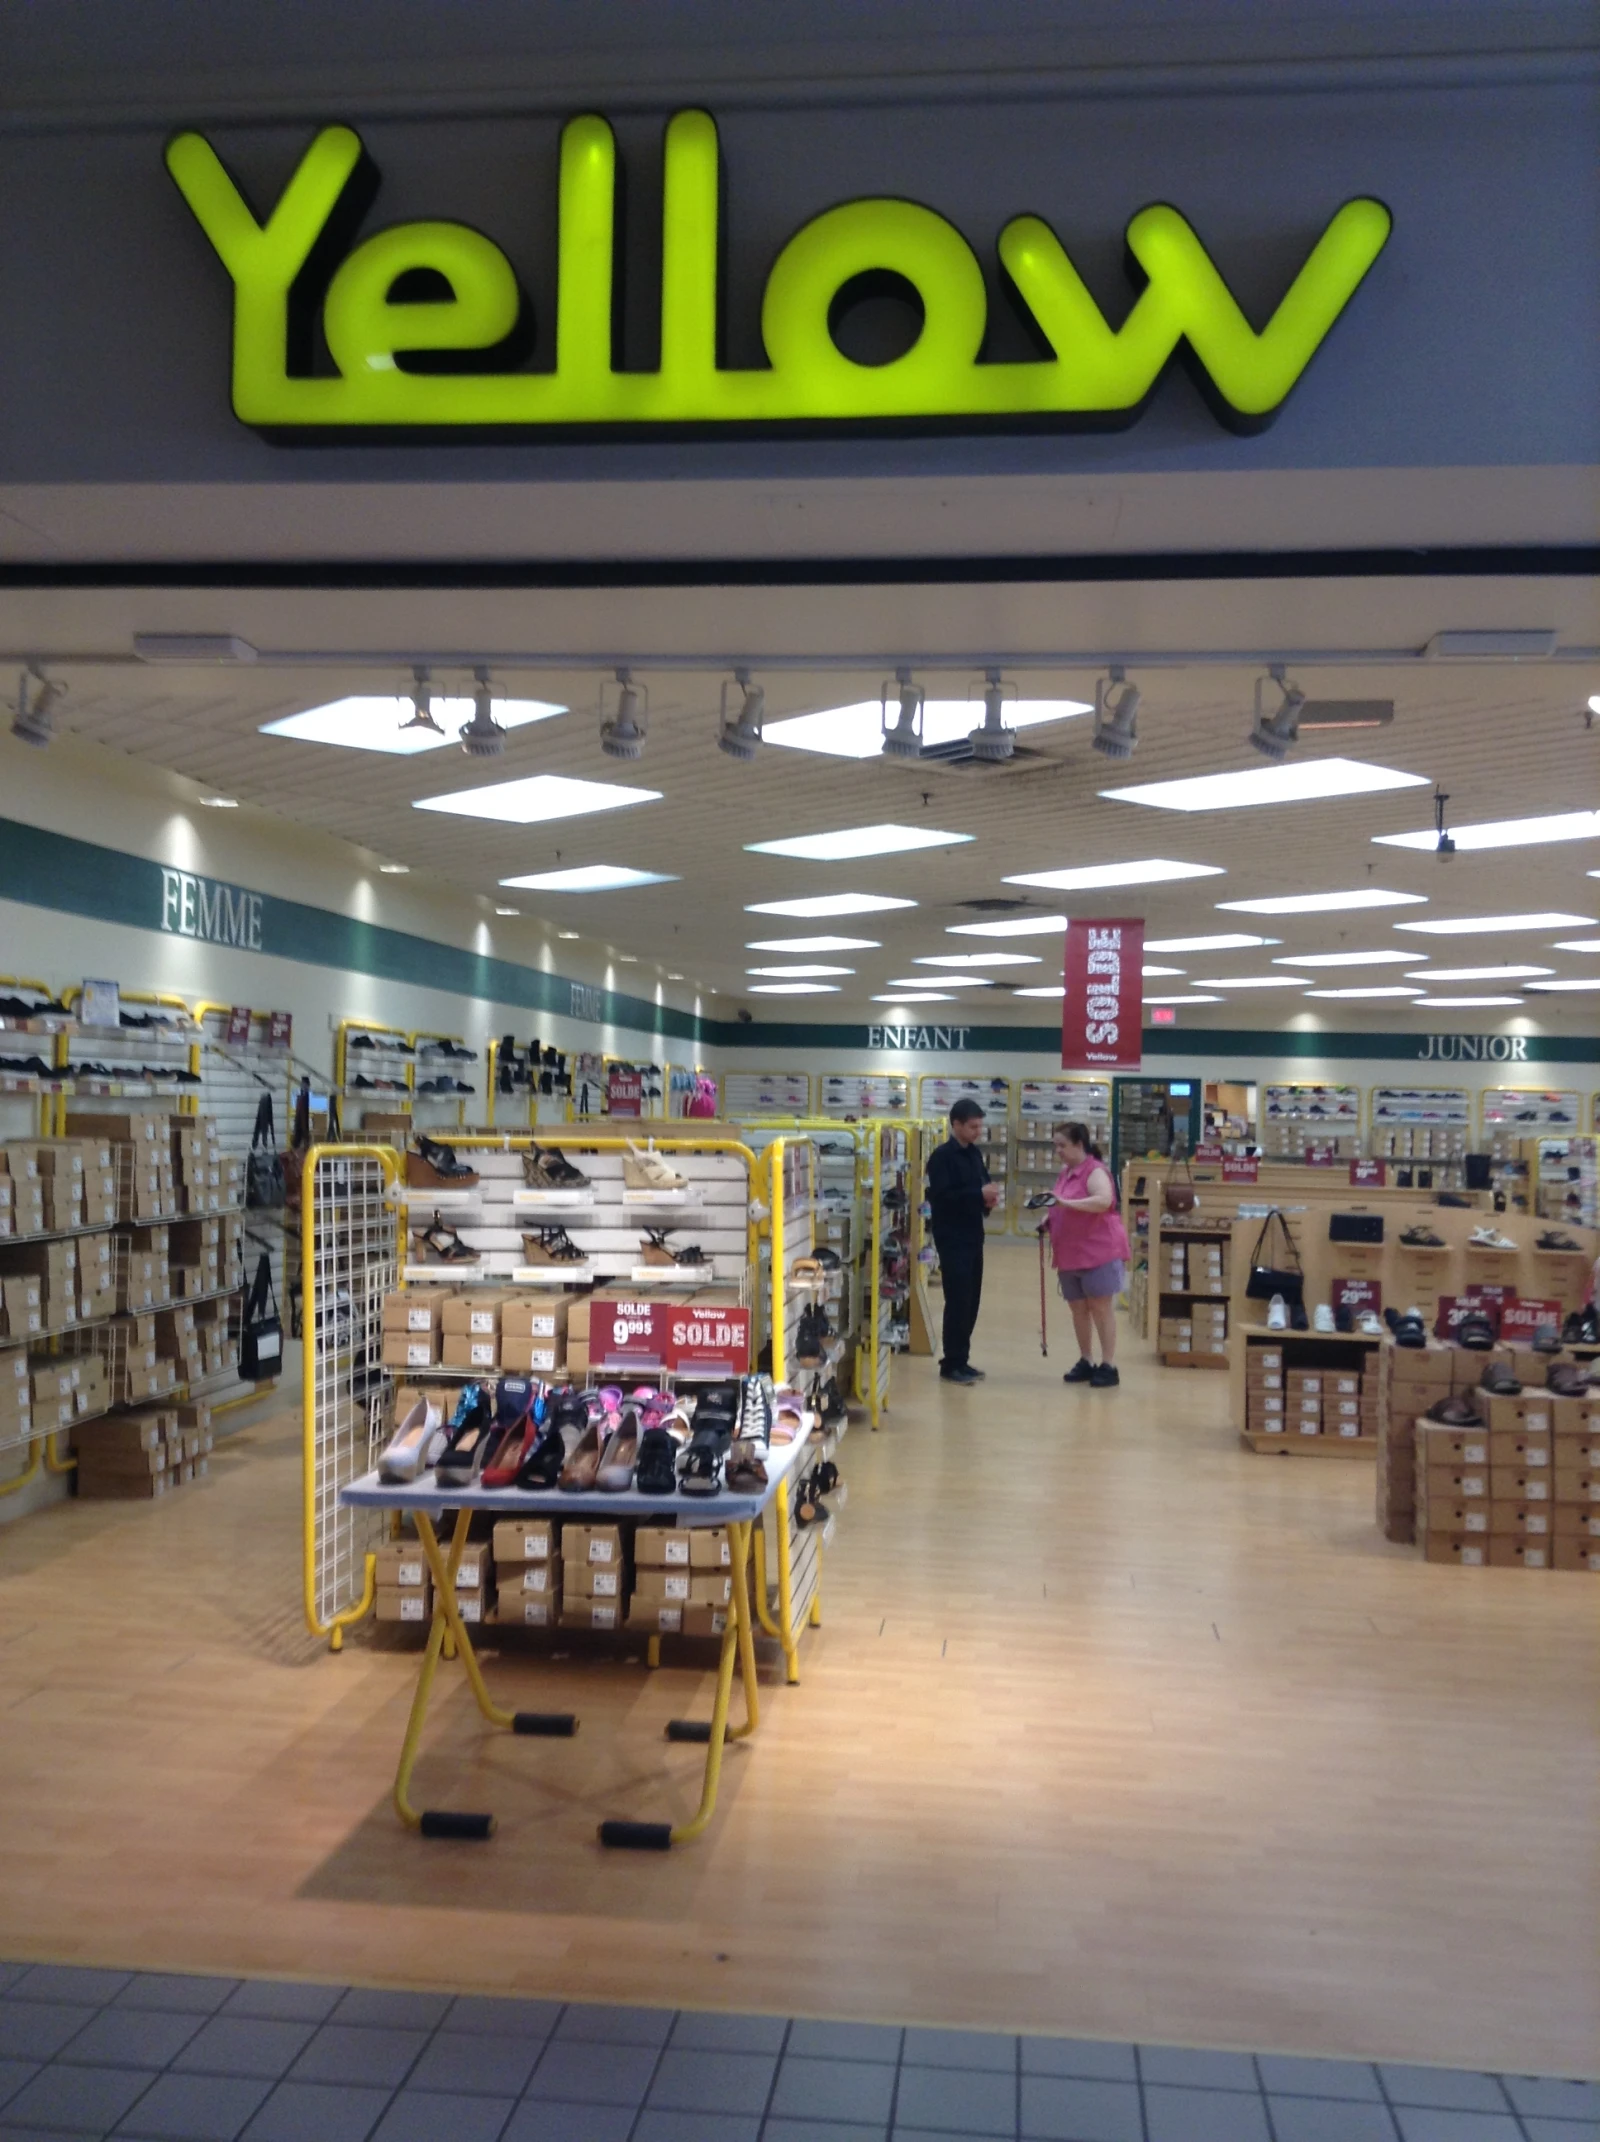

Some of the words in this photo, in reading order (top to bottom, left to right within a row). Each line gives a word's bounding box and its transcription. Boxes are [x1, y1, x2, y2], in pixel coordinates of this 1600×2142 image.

[164, 108, 1393, 427] Yellow
[160, 867, 263, 950] FEMME
[1085, 927, 1121, 1045] SOLDE
[867, 1026, 971, 1050] ENFANT
[1418, 1035, 1528, 1061] JUNIOR
[1085, 1051, 1118, 1062] Yellow
[610, 1083, 641, 1101] SOLDE
[1224, 1161, 1257, 1173] SOLDE
[616, 1301, 651, 1316] SOLDE
[692, 1307, 726, 1320] Yellow
[1504, 1308, 1558, 1328] SOLDE
[672, 1320, 745, 1348] SOLDE
